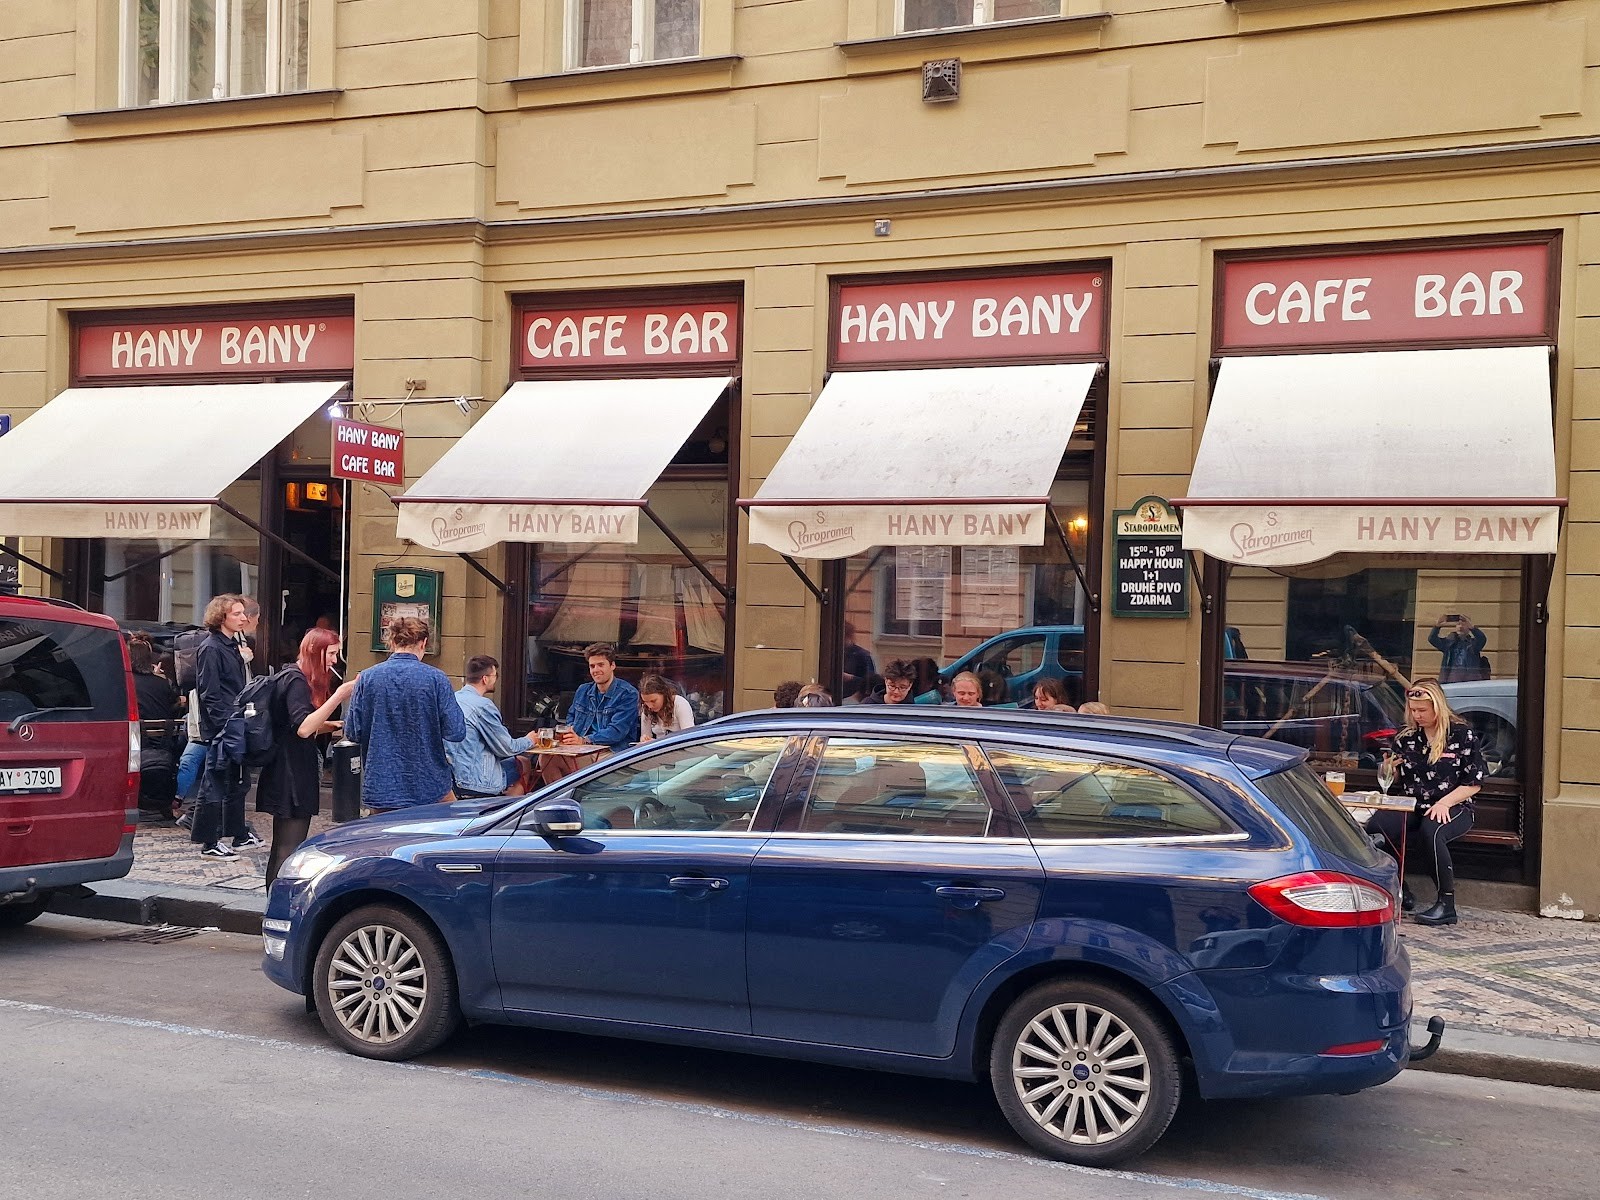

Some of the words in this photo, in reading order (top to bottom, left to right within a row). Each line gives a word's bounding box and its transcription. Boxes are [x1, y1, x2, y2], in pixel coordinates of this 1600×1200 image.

[1245, 277, 1372, 325] CAFE
[1414, 270, 1524, 318] BAR
[840, 300, 956, 343] HANY
[527, 315, 628, 359] CAFE
[644, 311, 729, 355] BAR
[111, 328, 202, 369] HANY
[338, 425, 369, 445] HANY
[371, 431, 400, 450] BANY
[341, 454, 369, 474] CAFE
[374, 459, 396, 478] BAR
[105, 511, 151, 531] HANY
[156, 511, 202, 530] BANY
[431, 517, 486, 547] Staropramen
[508, 513, 561, 534] HANY
[571, 514, 626, 535] BANY
[888, 514, 954, 536] HANY
[964, 513, 1032, 536] BANY
[1124, 522, 1180, 533] STAROPRAMEN
[1357, 517, 1443, 541] HANY
[1454, 516, 1543, 542] BANY
[788, 520, 855, 553] Staropramen
[1230, 522, 1314, 559] Staropramen
[1120, 559, 1153, 569] HAPPY
[1154, 559, 1184, 569] HOUR
[1143, 570, 1159, 581] 1+1
[1121, 580, 1156, 593] DRUHÉ
[1156, 582, 1182, 593] PIVO
[1130, 595, 1172, 605] ZDARMA
[24, 770, 55, 786] 3790
